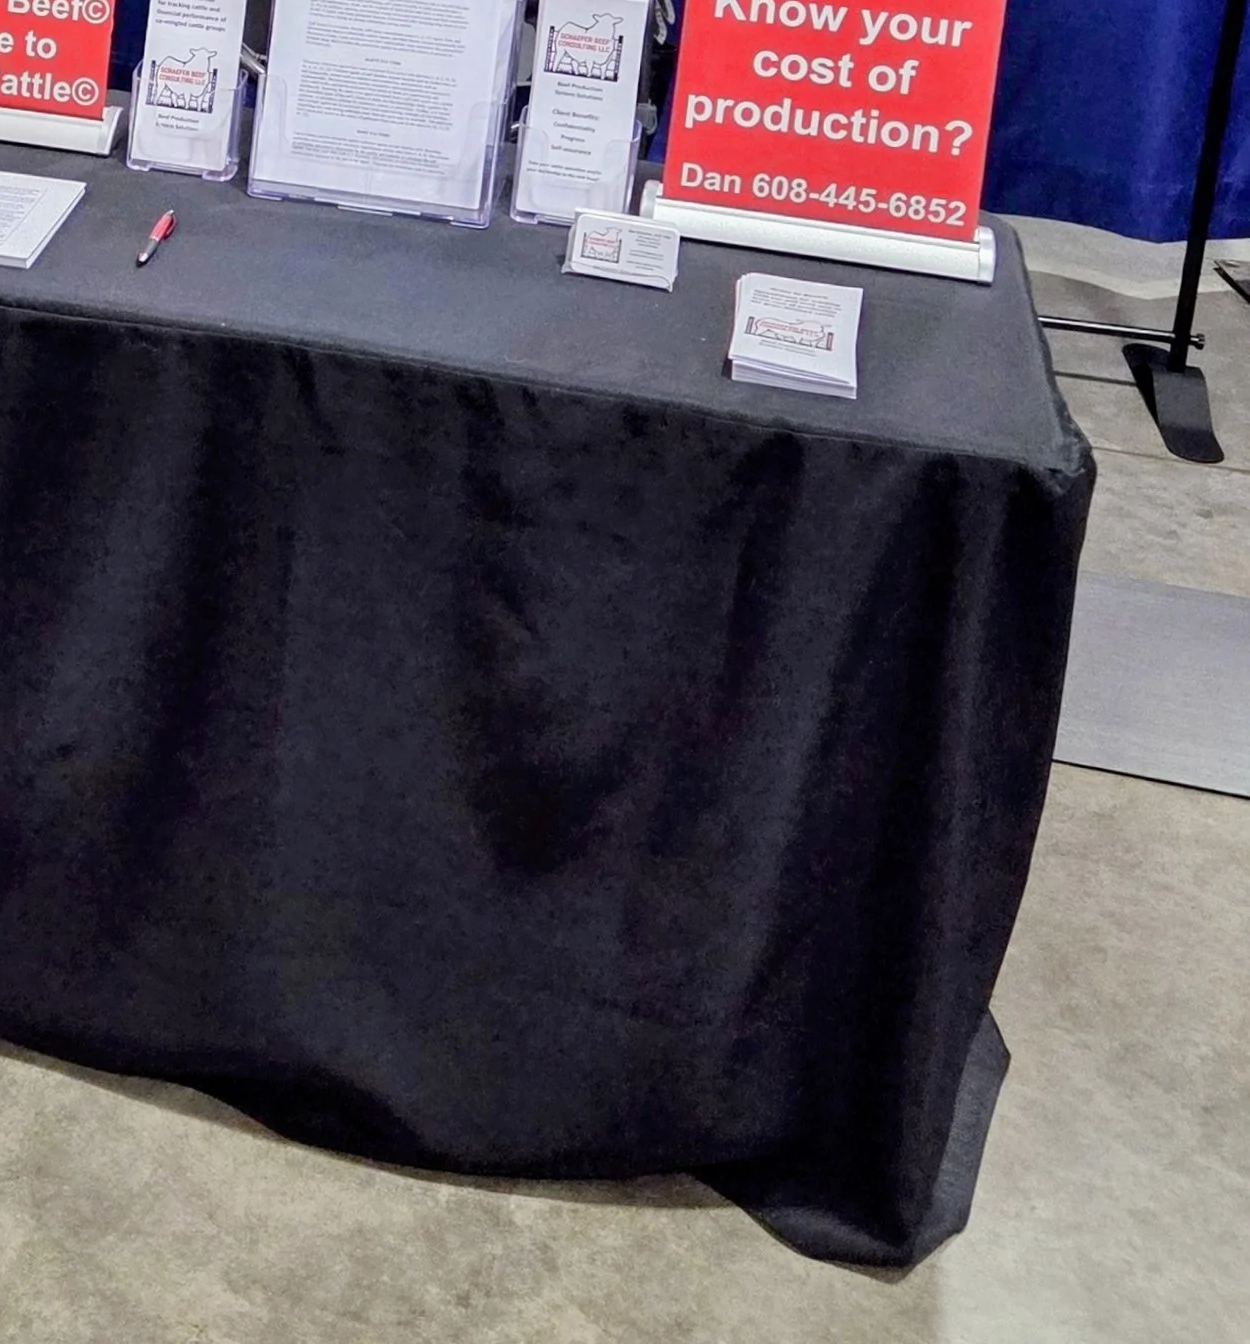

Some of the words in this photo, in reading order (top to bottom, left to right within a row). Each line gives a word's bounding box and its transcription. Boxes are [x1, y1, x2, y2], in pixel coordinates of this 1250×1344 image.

[25, 30, 57, 59] to
[859, 5, 973, 48] your
[753, 49, 854, 88] cost
[867, 59, 919, 96] of
[684, 93, 974, 156] production?
[679, 162, 743, 195] Dan
[752, 172, 967, 228] 608-445-6852
